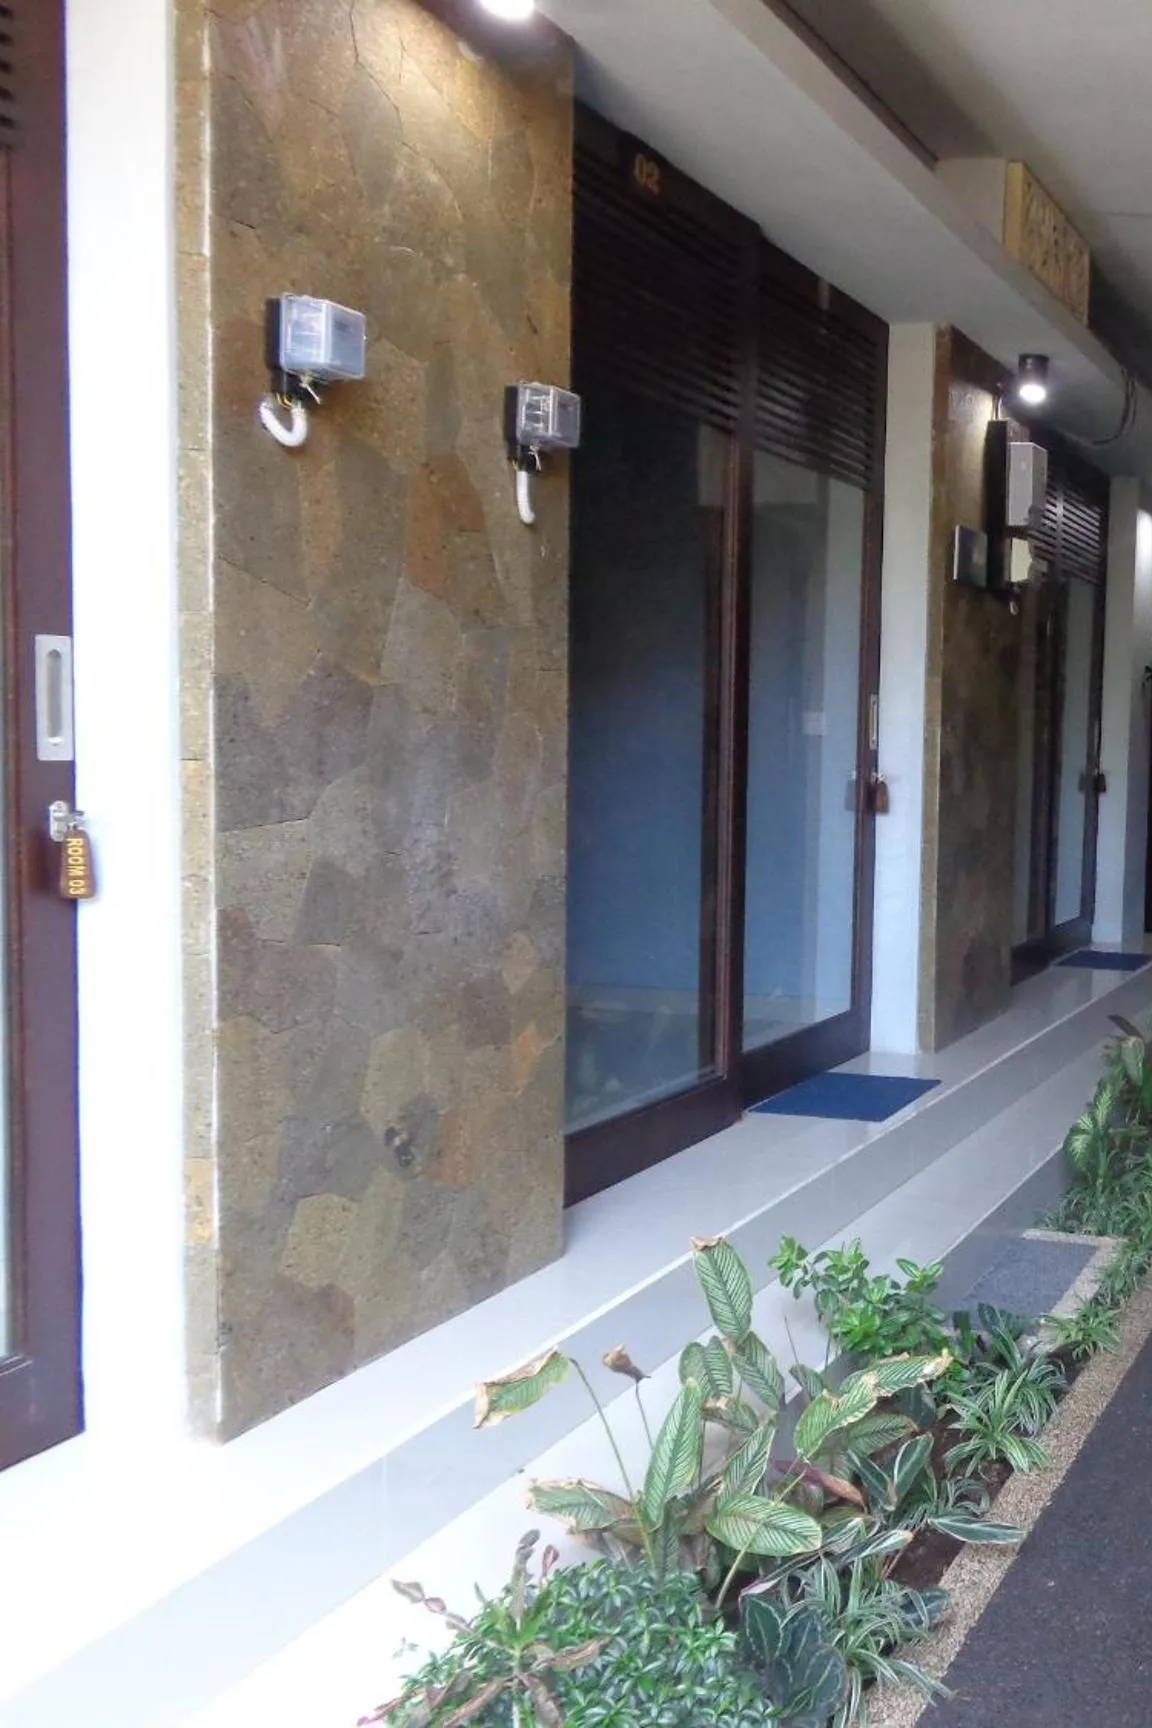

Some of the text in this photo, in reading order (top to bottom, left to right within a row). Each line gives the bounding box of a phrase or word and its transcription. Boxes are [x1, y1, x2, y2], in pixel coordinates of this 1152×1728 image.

[633, 153, 660, 195] 02
[66, 838, 87, 895] ROOM 03
